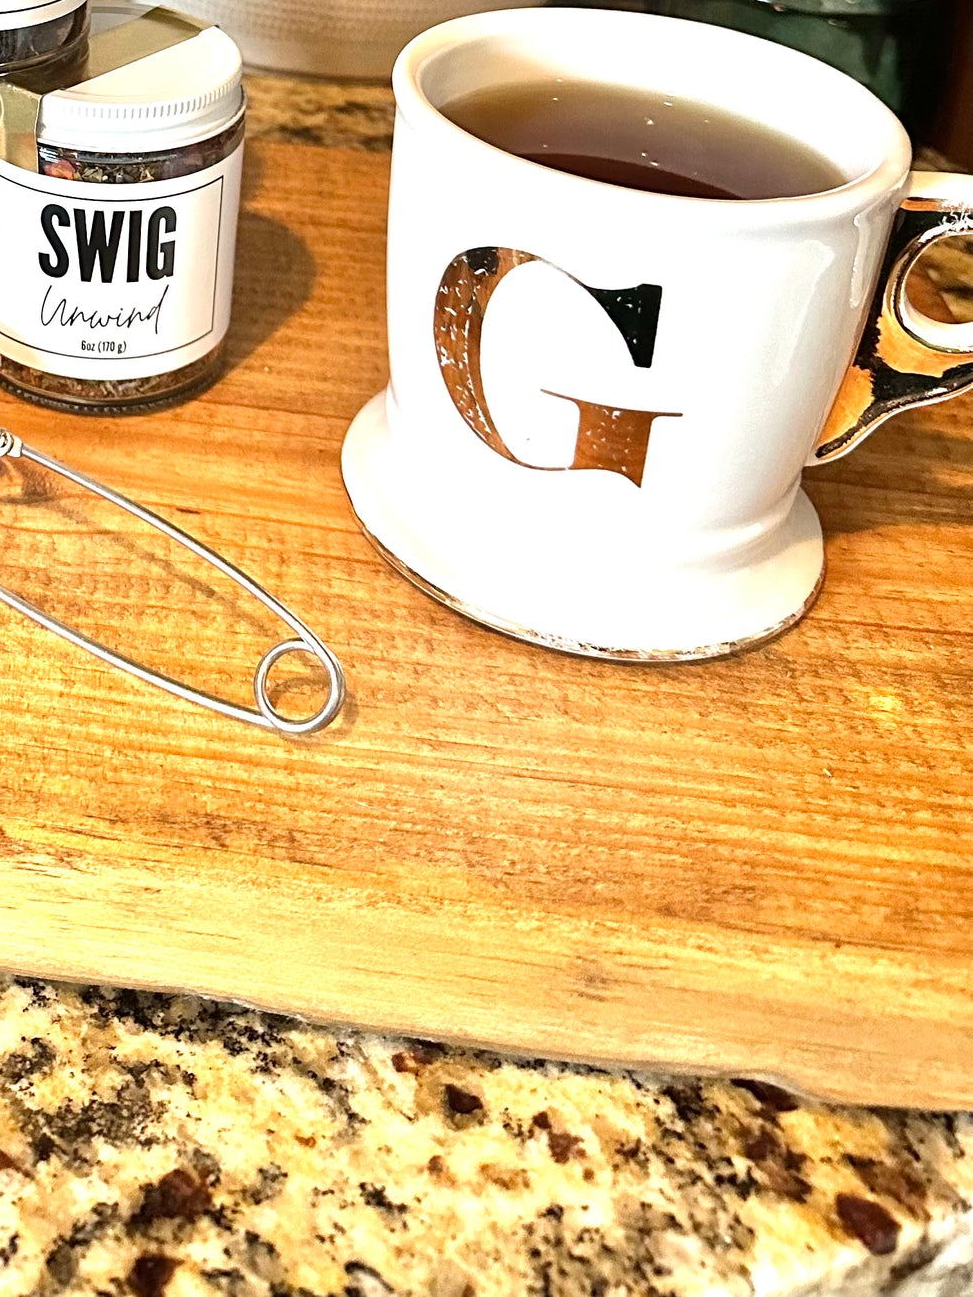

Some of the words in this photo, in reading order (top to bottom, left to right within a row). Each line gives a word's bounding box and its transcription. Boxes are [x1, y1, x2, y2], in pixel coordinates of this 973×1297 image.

[39, 204, 176, 283] SWIG
[41, 285, 169, 334] Unwind
[82, 340, 95, 351] 6oz
[98, 342, 115, 353] (170
[118, 341, 126, 354] g)
[433, 246, 683, 488] G
